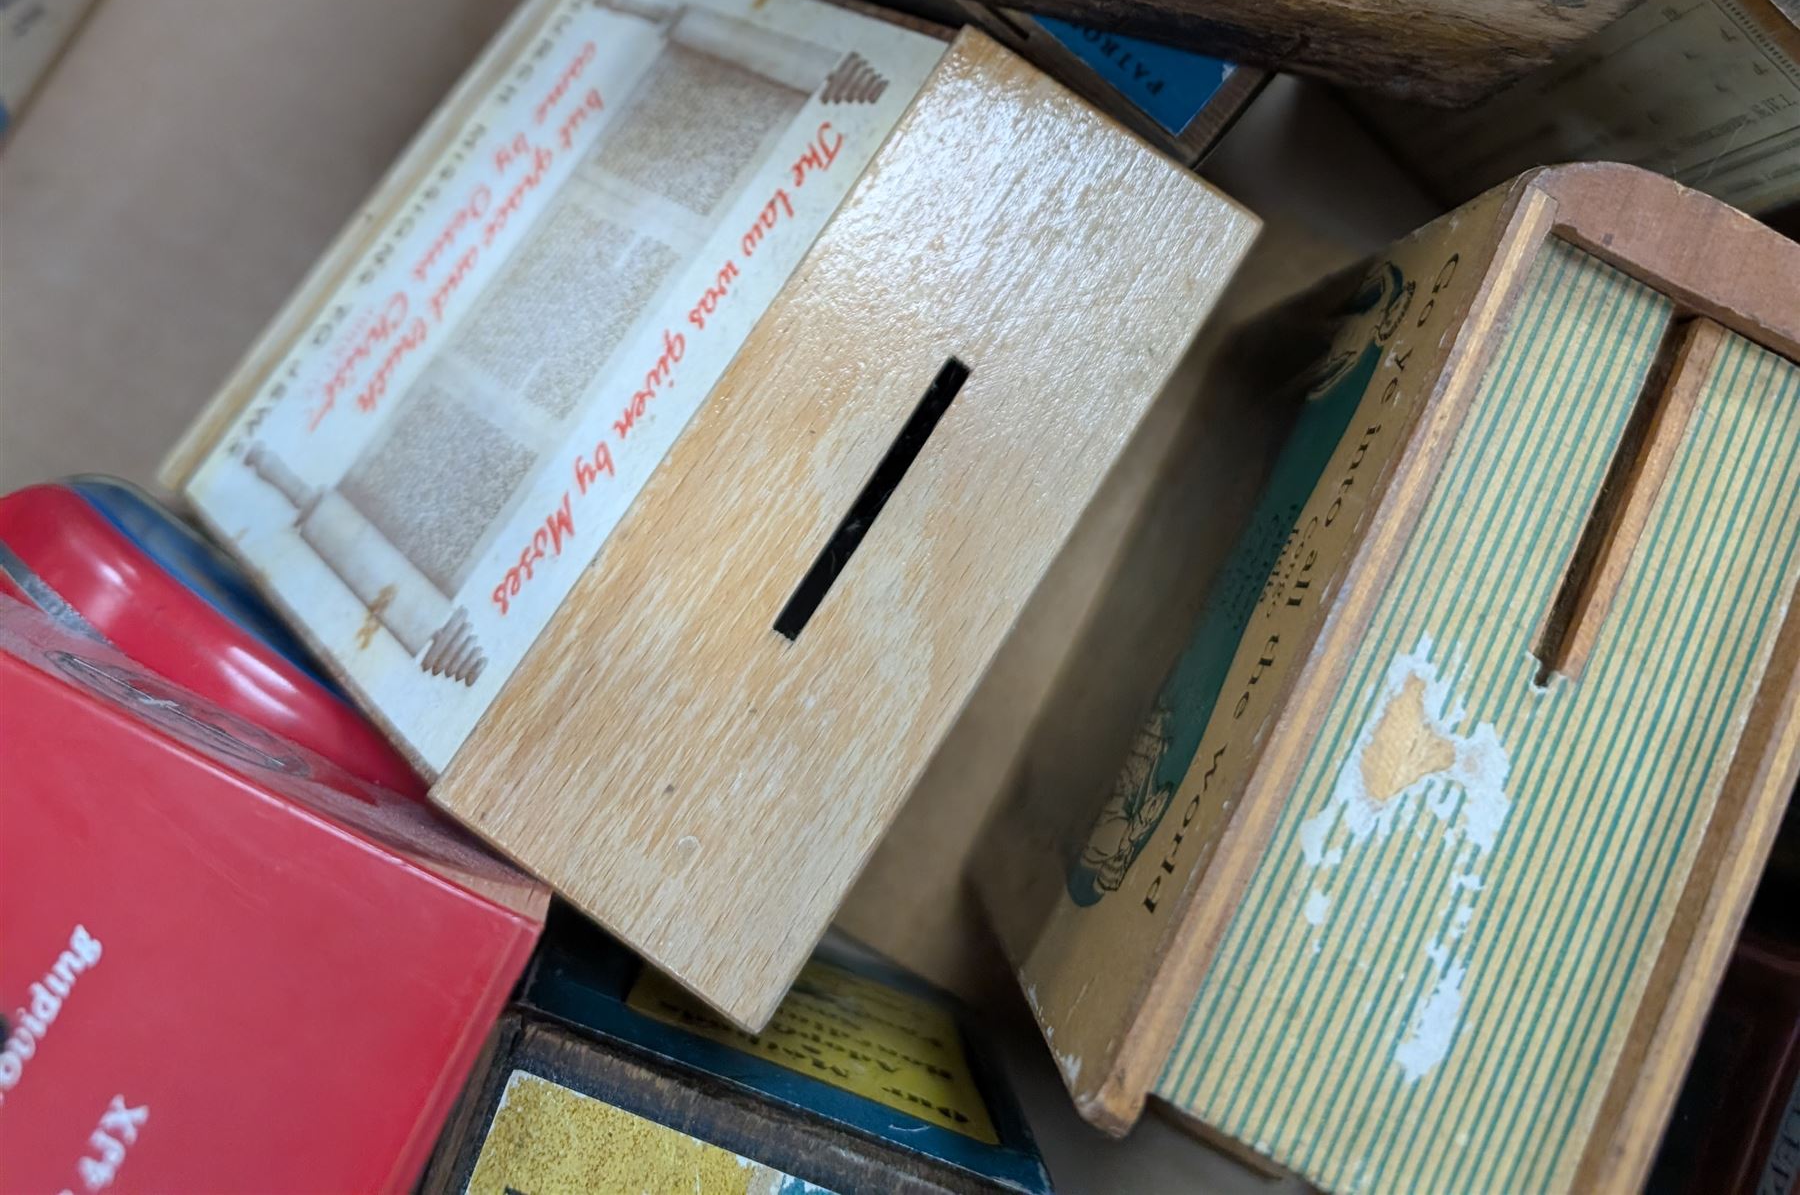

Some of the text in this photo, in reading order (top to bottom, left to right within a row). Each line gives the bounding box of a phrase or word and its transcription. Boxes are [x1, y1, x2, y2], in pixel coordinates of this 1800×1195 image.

[494, 131, 530, 175] by
[356, 86, 605, 413] but grace and truth
[1415, 251, 1461, 329] Go
[491, 121, 844, 616] The law was given by Moses
[1380, 346, 1415, 406] ye
[1324, 423, 1382, 528] into
[1264, 514, 1319, 620] Congo
[1286, 549, 1319, 607] all
[1232, 633, 1281, 721] the
[1142, 742, 1229, 914] world
[0, 923, 103, 1103] oviding
